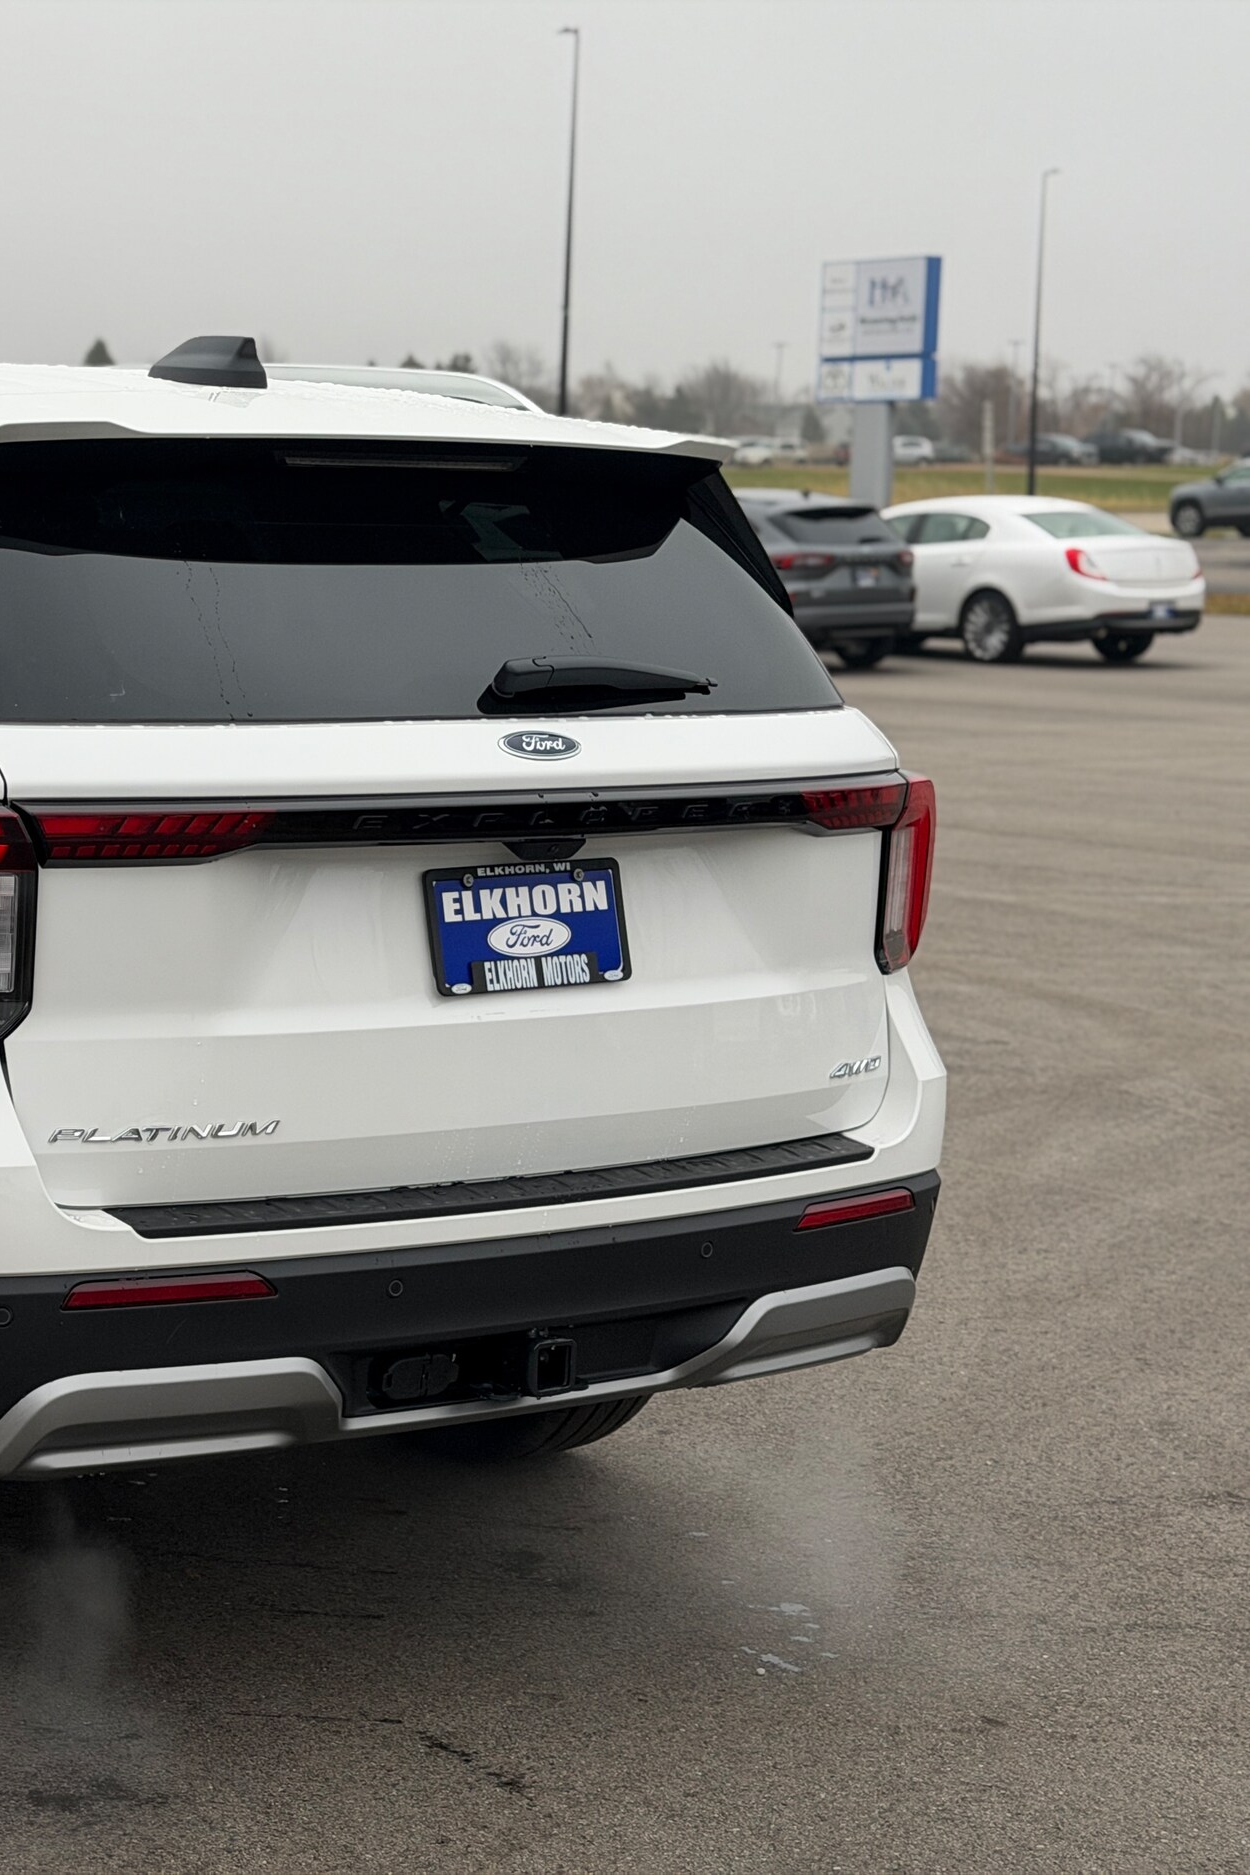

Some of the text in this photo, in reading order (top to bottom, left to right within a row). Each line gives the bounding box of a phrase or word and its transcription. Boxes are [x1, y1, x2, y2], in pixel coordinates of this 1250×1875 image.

[521, 734, 566, 751] Ford
[476, 862, 572, 877] ELKHORN, WI
[441, 880, 609, 923] ELKHORN
[505, 923, 554, 949] Ford
[483, 953, 591, 992] ELKHORN MOTORS
[829, 1055, 882, 1079] 4WD
[47, 1119, 281, 1144] PLATINUM
